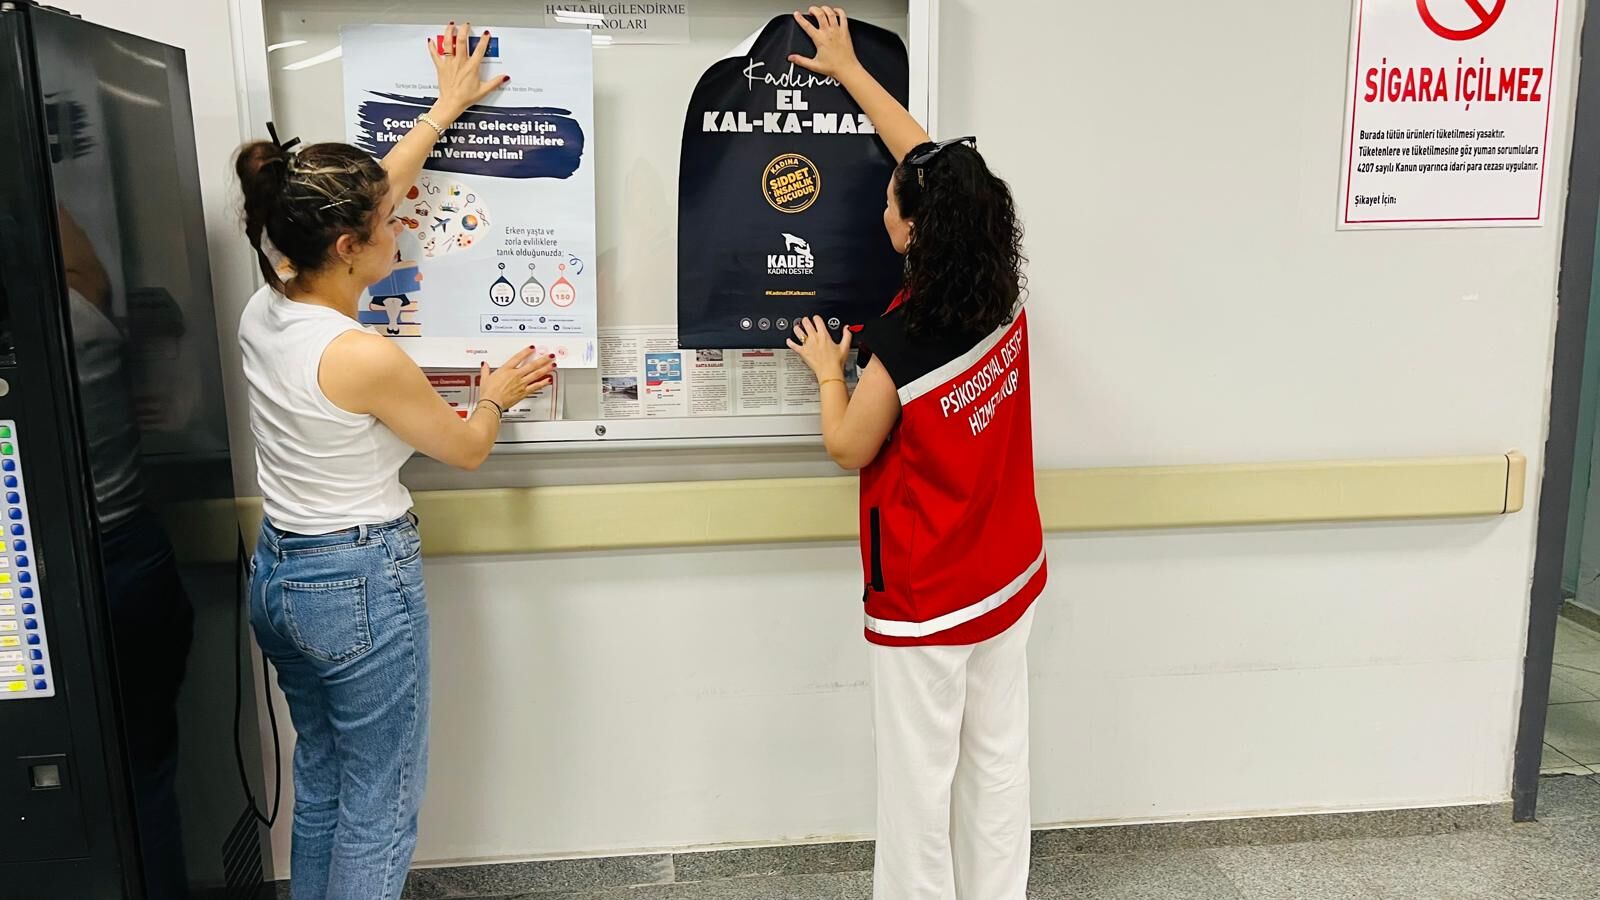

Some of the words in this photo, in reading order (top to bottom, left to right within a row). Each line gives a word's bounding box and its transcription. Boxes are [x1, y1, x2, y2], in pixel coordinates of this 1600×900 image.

[589, 2, 686, 15] BİLGİLENDİRME
[1364, 57, 1448, 103] SİGARA
[1455, 57, 1544, 111] İÇİLMEZ
[776, 89, 808, 111] EL
[479, 120, 534, 132] Geleceği
[535, 120, 556, 133] için
[377, 132, 402, 142] Erke
[450, 136, 465, 144] ve
[468, 134, 500, 145] Zorla
[502, 135, 564, 146] Evliliklere
[1359, 130, 1385, 140] Burada
[1386, 129, 1405, 139] tütün
[1406, 129, 1435, 139] ürünleri
[1436, 128, 1476, 139] tüketilmesi
[1476, 129, 1505, 141] yasaktır.
[444, 148, 523, 162] Vermeyelim!
[1359, 146, 1401, 157] Tüketenlere
[1402, 148, 1410, 156] ve
[1411, 145, 1459, 156] tüketilmesine
[1460, 145, 1472, 157] göz
[1473, 147, 1496, 157] yuman
[1497, 145, 1539, 155] sorumlulara
[770, 158, 799, 174] KADINA
[1357, 162, 1375, 173] 4207
[1375, 162, 1394, 175] sayılı
[1395, 162, 1417, 172] Kanun
[1418, 163, 1448, 174] uyarınca
[1449, 161, 1466, 172] idari
[1466, 163, 1482, 173] para
[1483, 163, 1505, 171] cezası
[1505, 162, 1539, 173] uygulanır.
[773, 176, 814, 198] İNSANLIK
[775, 185, 815, 205] SUÇUDUR
[1354, 195, 1380, 207] Şikayet
[1381, 192, 1397, 207] İçin:
[505, 226, 525, 235] Erken
[526, 227, 544, 237] yaşta
[504, 237, 522, 246] zorla
[523, 238, 558, 246] evliliklere
[496, 248, 514, 256] tanık
[767, 254, 814, 268] KADES
[939, 354, 1004, 418] PSİKOSOSYAL
